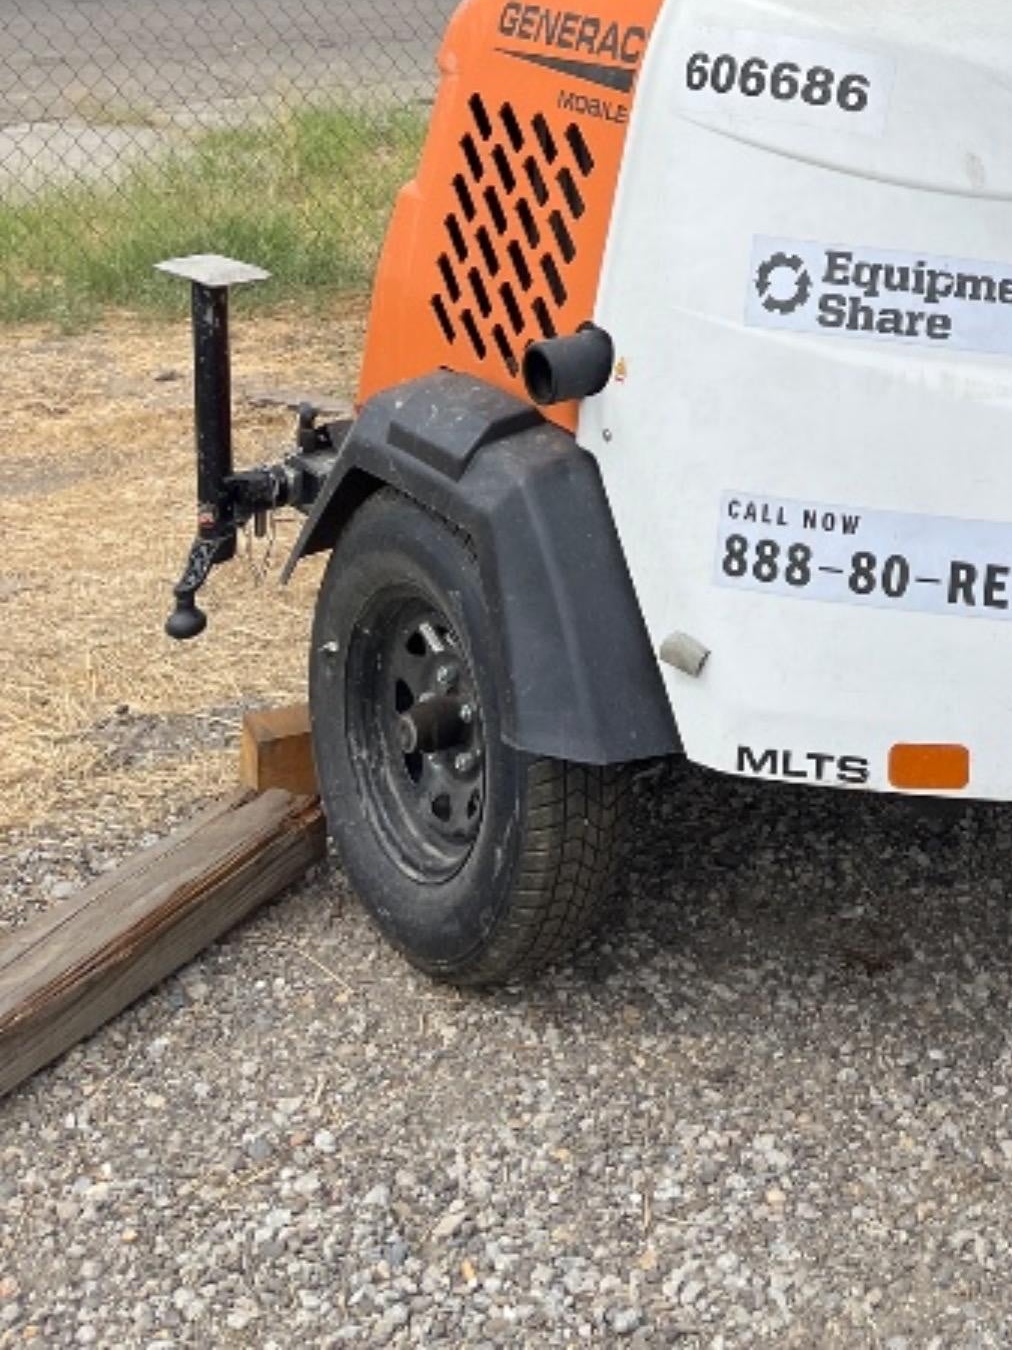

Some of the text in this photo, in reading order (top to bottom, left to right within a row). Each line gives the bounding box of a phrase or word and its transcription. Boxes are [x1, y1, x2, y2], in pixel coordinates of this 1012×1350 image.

[498, 1, 646, 63] GENERAC
[686, 52, 871, 112] 606686
[557, 89, 629, 124] MOBILE
[817, 293, 951, 340] Share
[727, 500, 862, 535] CALL NOW
[737, 744, 869, 784] MLTS
